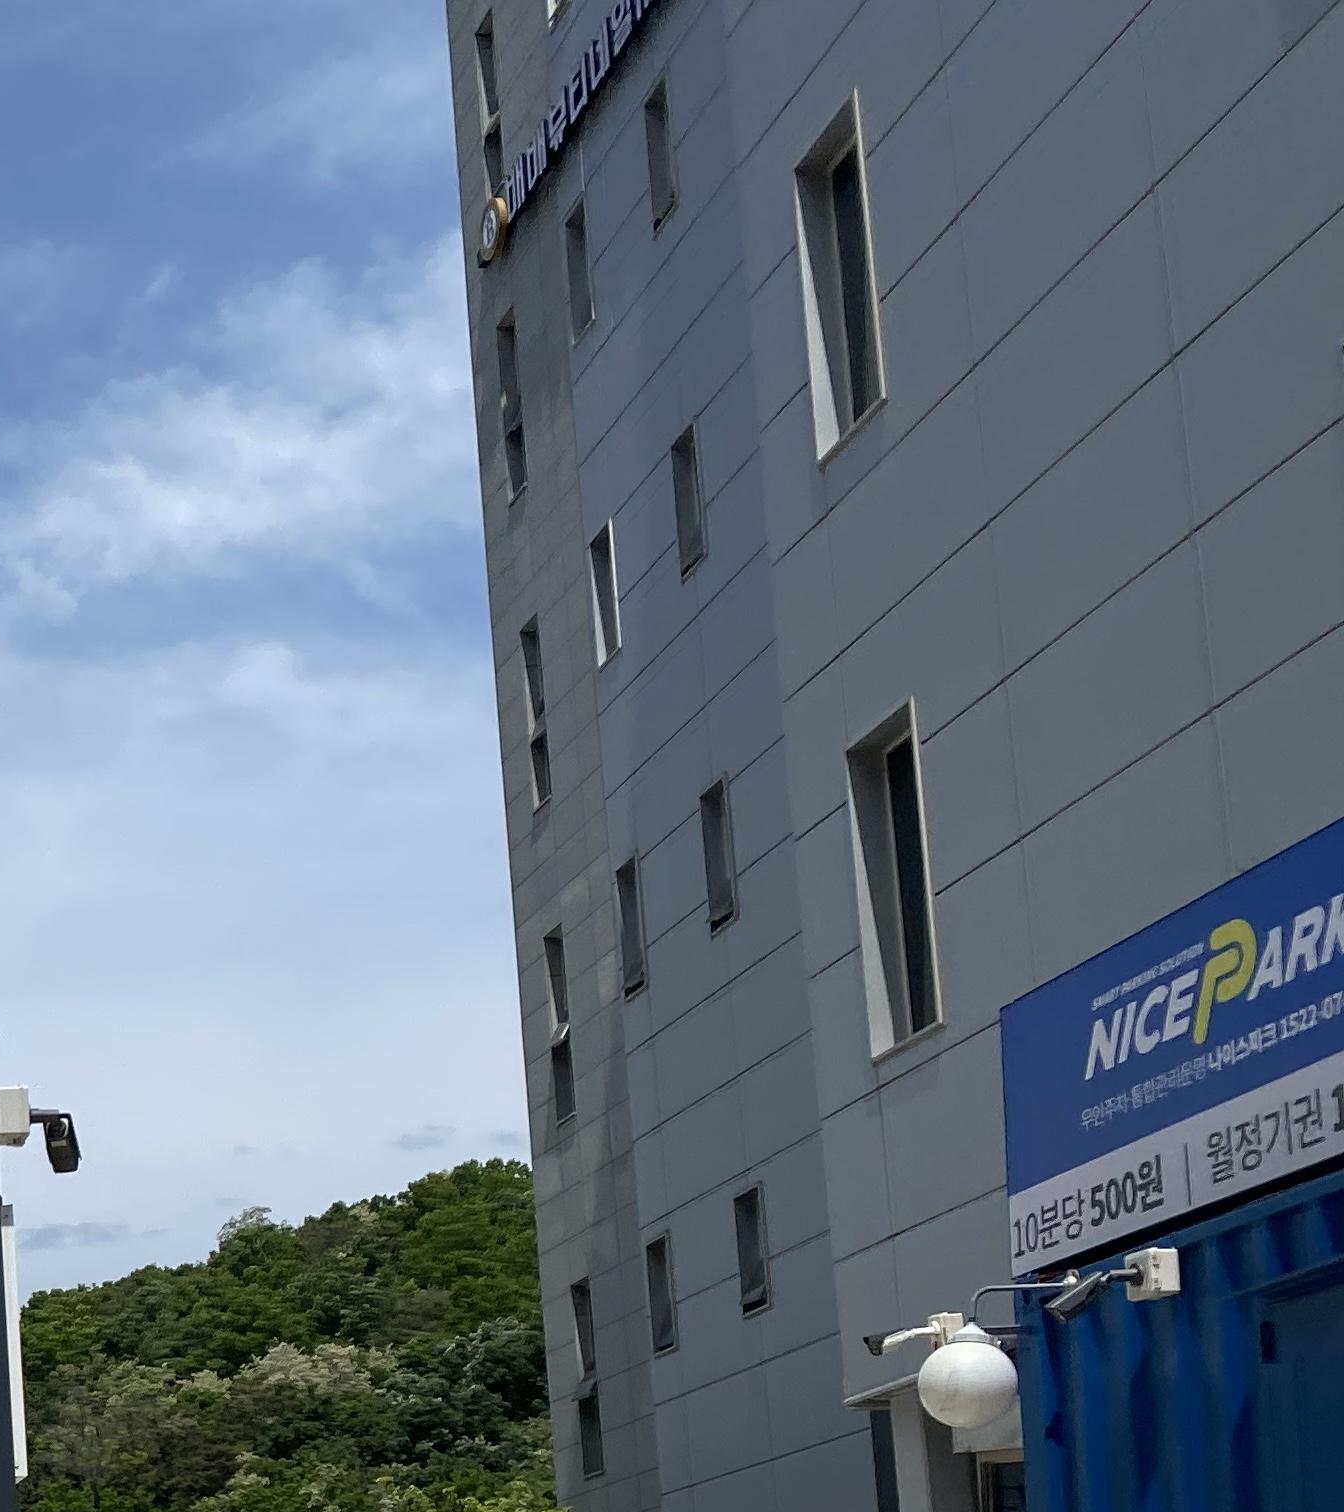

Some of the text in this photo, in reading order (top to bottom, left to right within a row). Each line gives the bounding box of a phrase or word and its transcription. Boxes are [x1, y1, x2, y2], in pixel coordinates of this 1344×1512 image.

[1013, 1187, 1085, 1259] 10분당
[1091, 1153, 1166, 1228] 500원
[1206, 1087, 1326, 1186] 월정기권
